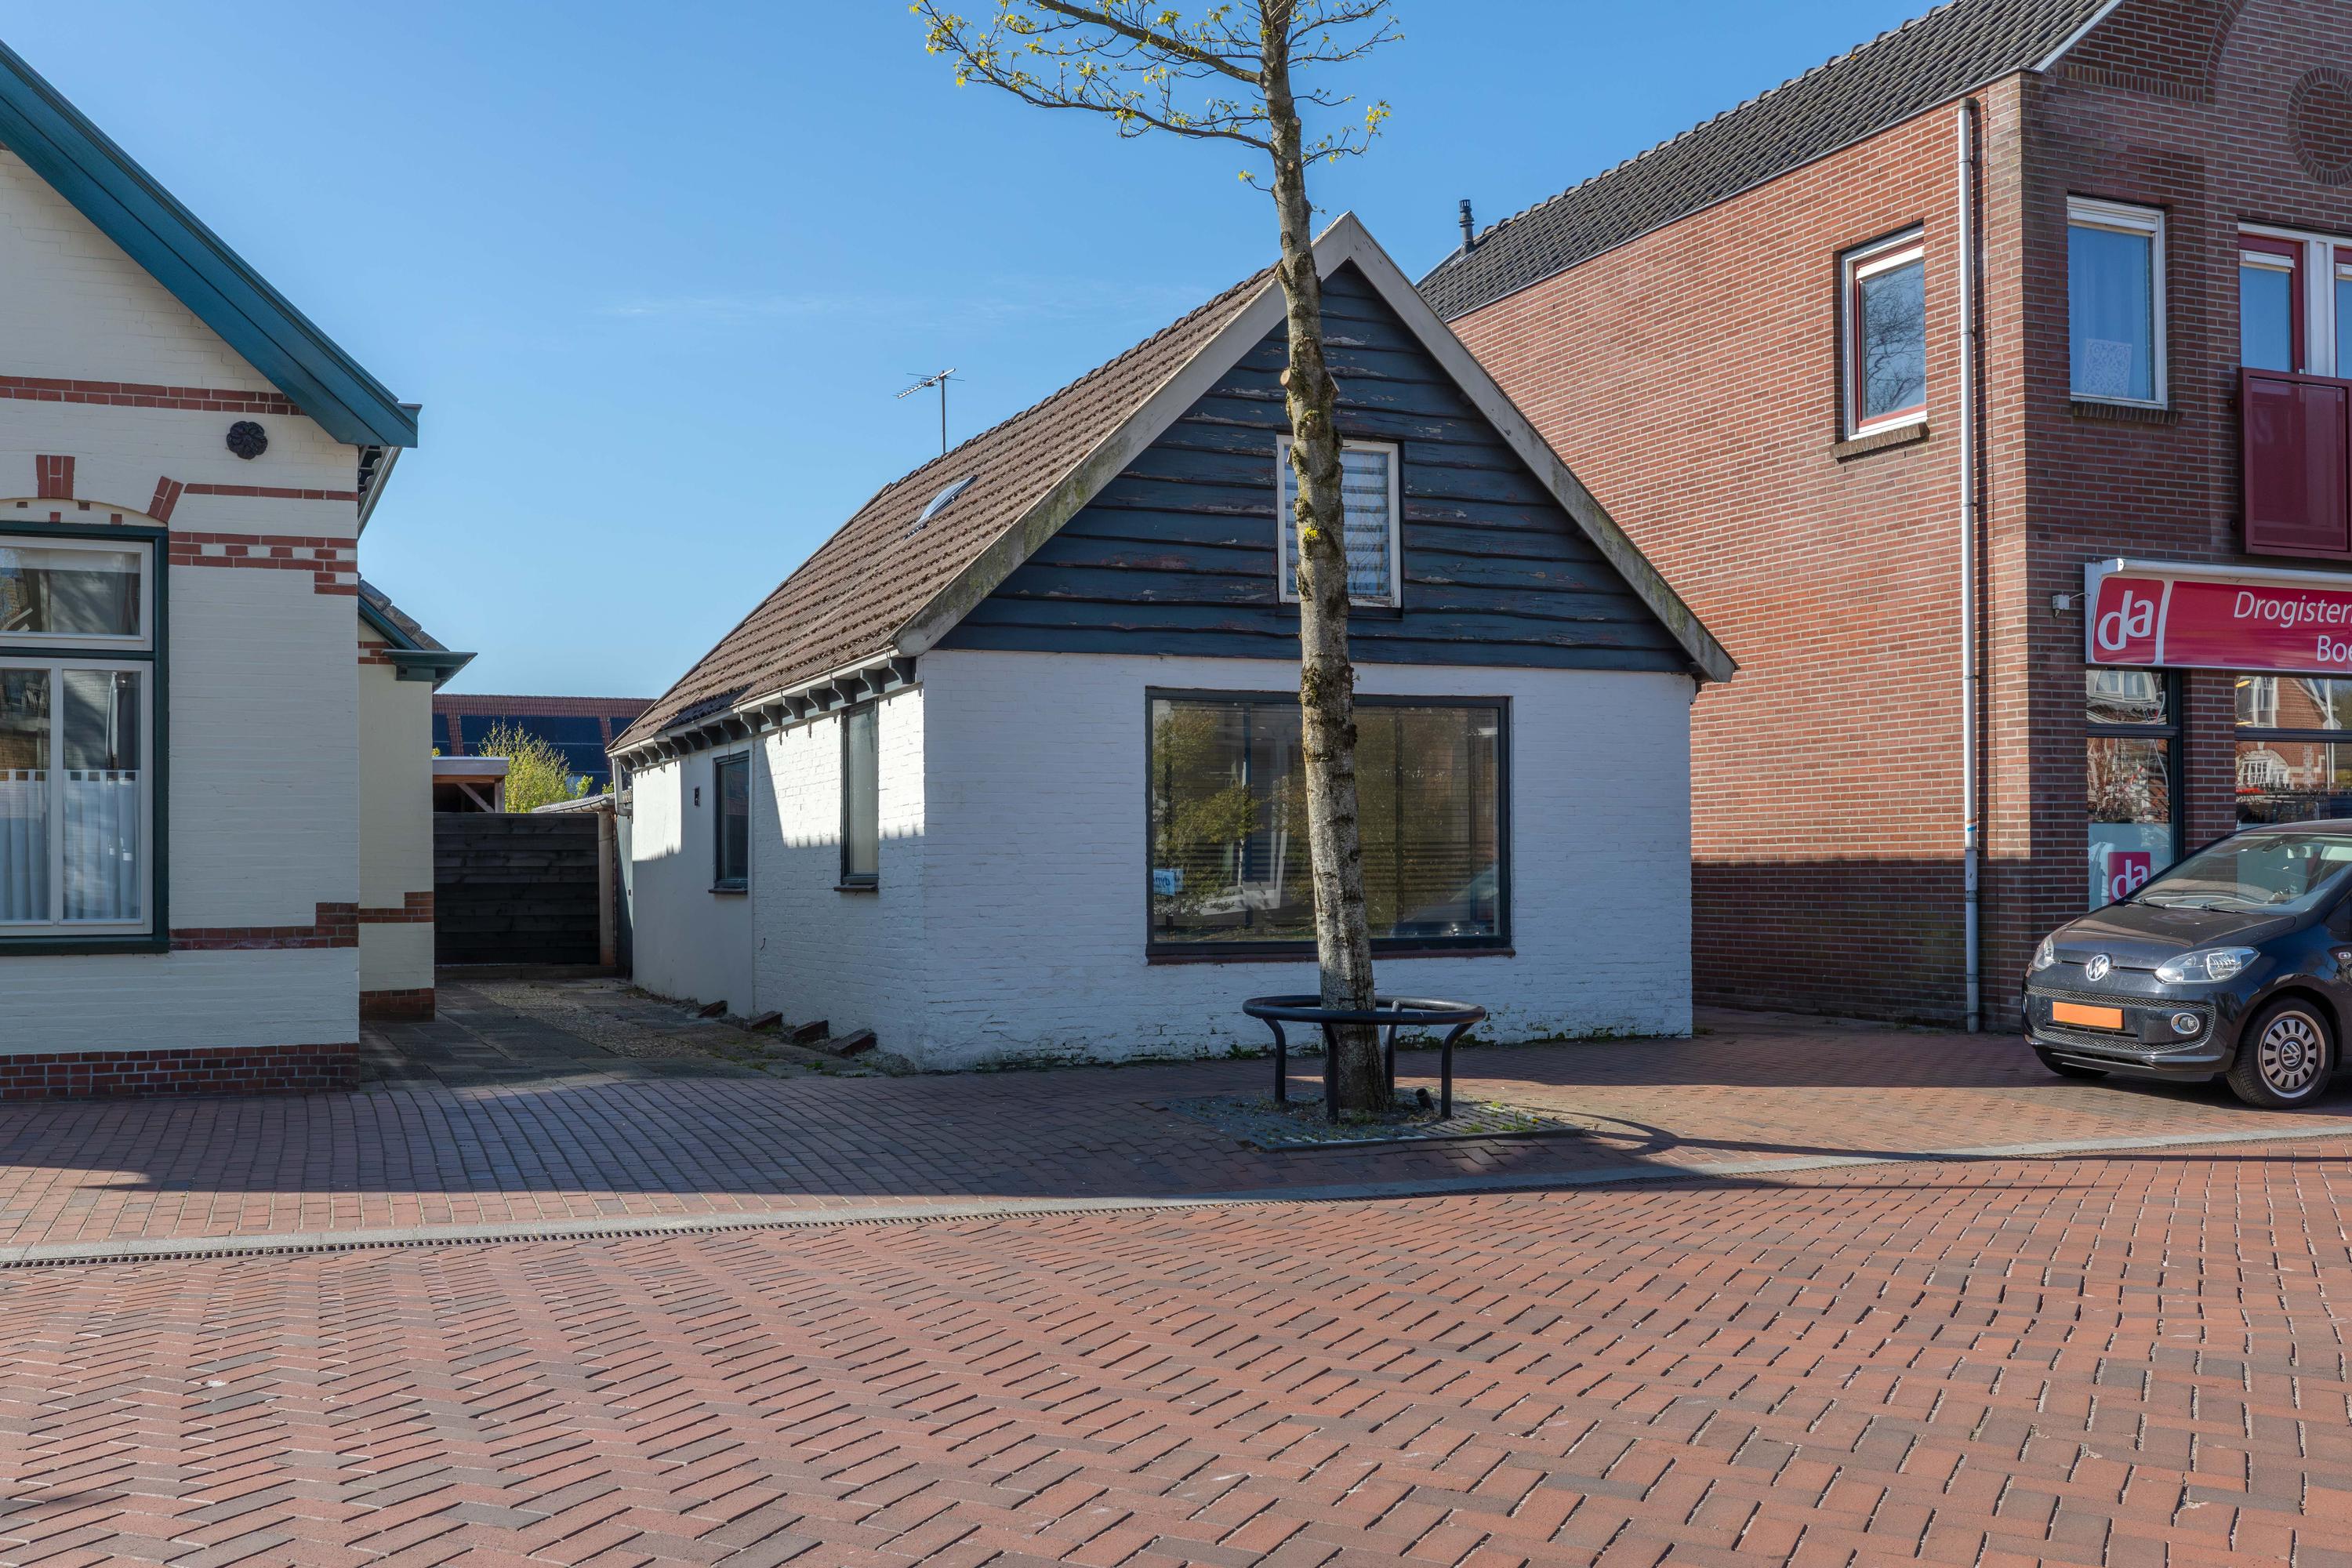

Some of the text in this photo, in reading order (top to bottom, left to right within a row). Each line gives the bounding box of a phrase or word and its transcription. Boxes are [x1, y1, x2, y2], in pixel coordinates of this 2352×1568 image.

[2097, 590, 2154, 651] da
[2234, 591, 2352, 628] Drogister
[2111, 859, 2148, 900] da
